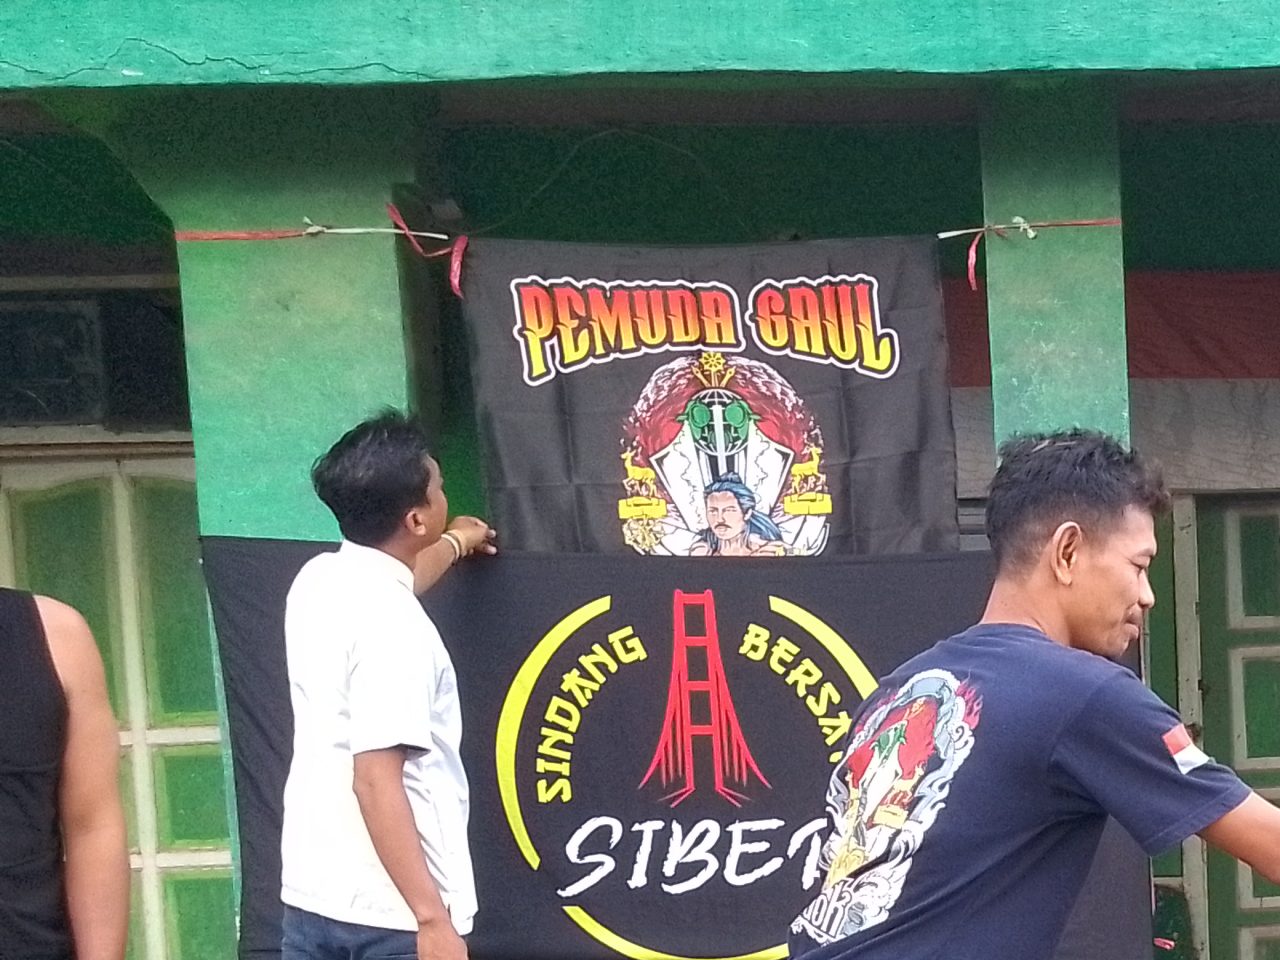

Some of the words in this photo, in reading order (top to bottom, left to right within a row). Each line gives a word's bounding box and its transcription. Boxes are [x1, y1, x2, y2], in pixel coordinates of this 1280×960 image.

[511, 275, 744, 386] PEMUDA
[746, 274, 900, 379] GAUL
[536, 626, 648, 804] SINDANG
[739, 623, 853, 763] BERSA
